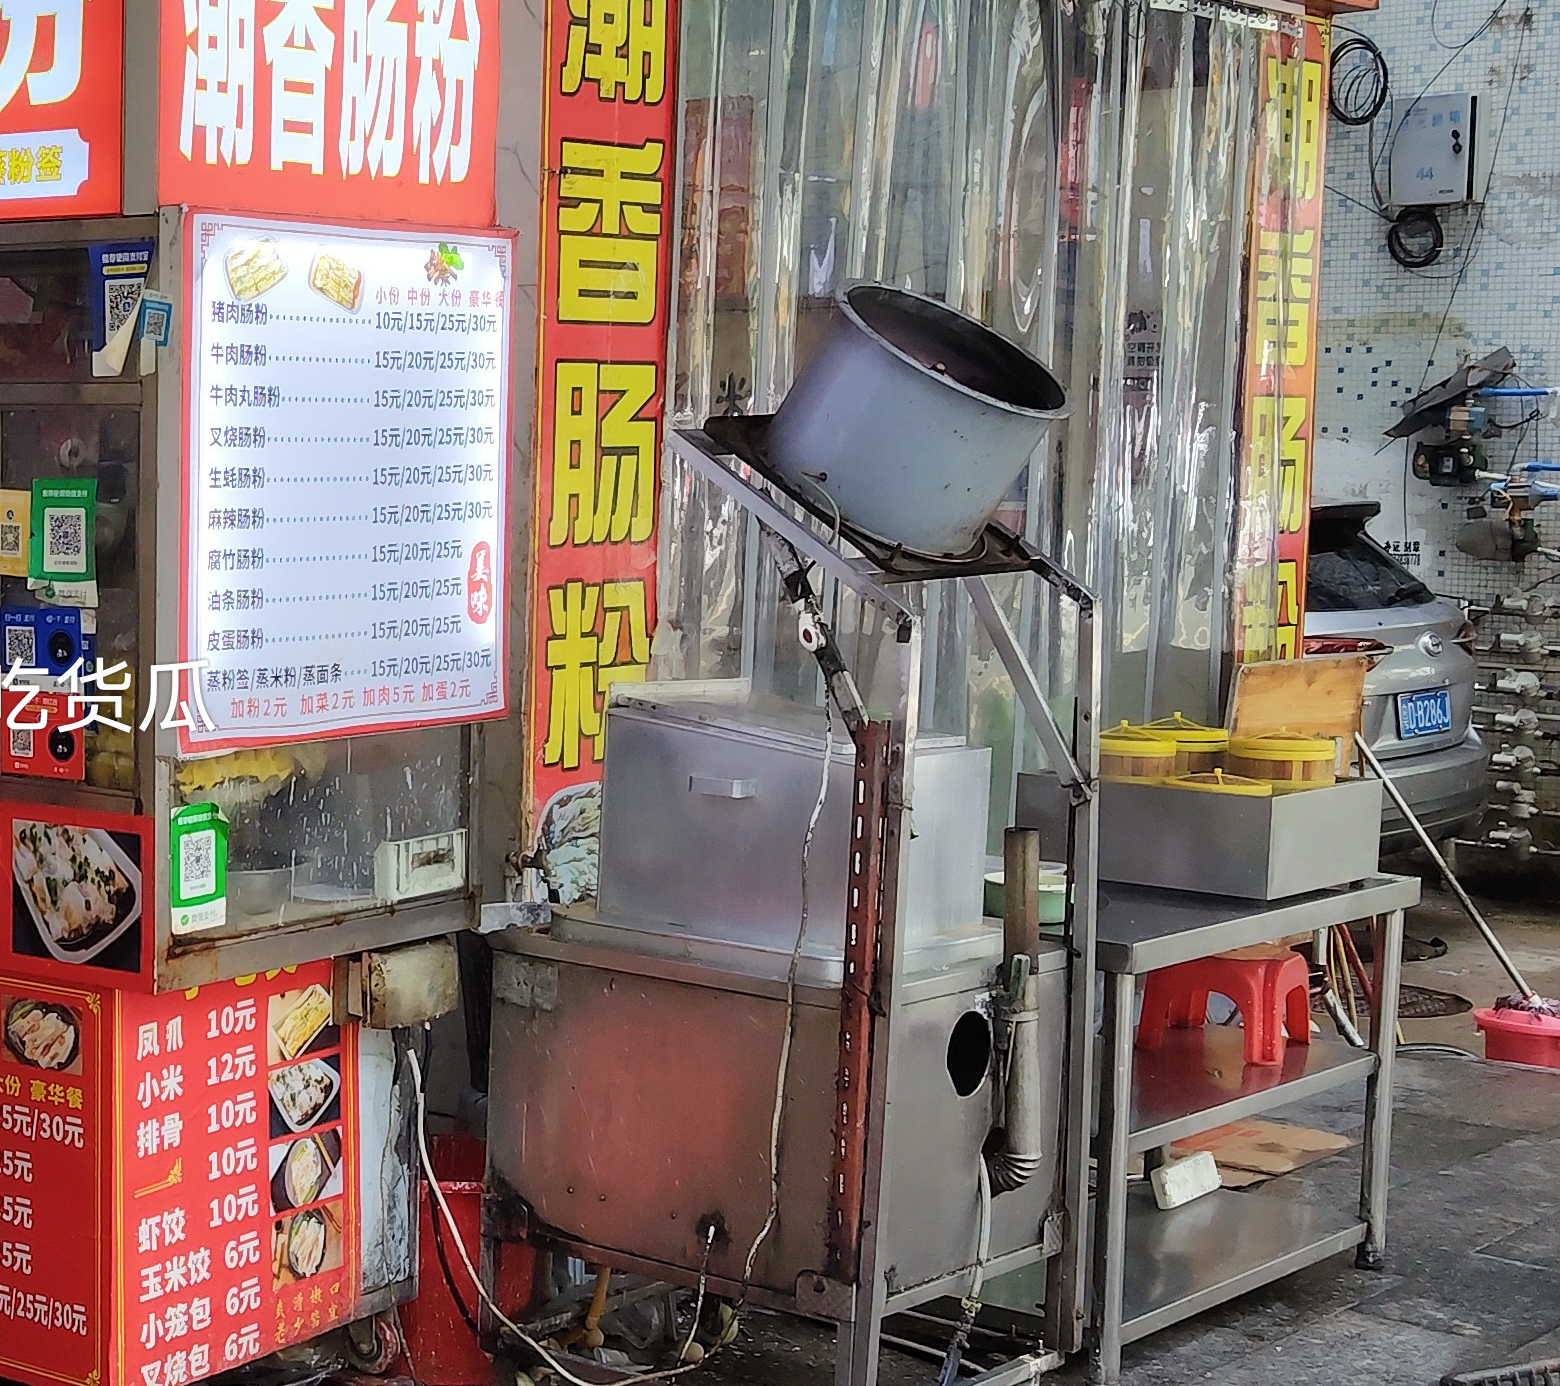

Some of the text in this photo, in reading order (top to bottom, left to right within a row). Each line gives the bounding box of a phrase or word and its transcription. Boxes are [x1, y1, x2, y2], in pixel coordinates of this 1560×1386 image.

[137, 997, 257, 1062] 凤爪 10元
[137, 1044, 256, 1110] 小米 12元
[137, 1090, 257, 1159] 排骨 10元
[207, 1137, 258, 1182] 10元
[137, 1184, 259, 1256] 虾饺 10元
[139, 1231, 260, 1303] 玉米饺 6元
[139, 1277, 261, 1351] 小笼包 6元
[224, 1323, 261, 1363] 6元
